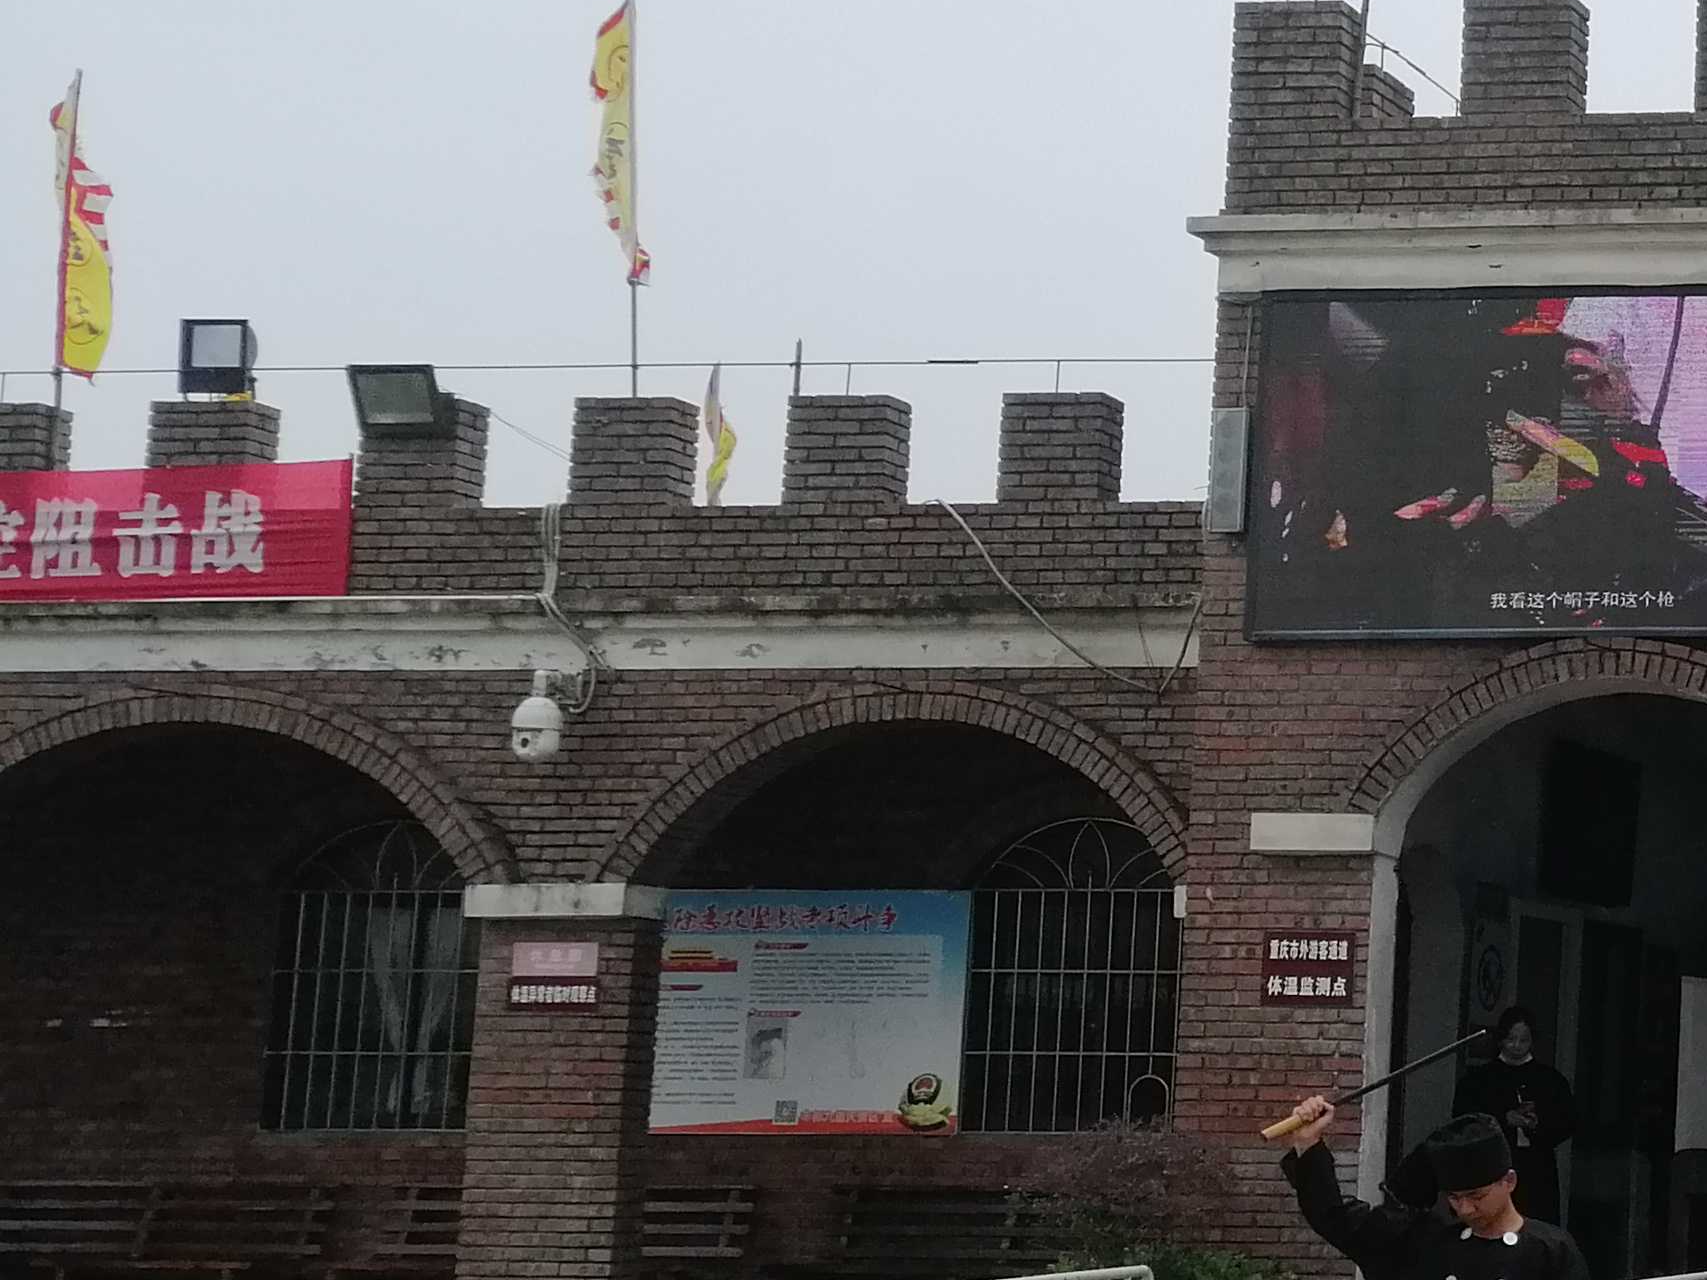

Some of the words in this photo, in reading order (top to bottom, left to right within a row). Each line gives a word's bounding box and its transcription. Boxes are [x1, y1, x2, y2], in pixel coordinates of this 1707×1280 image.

[1489, 590, 1675, 609] 我看这个帽子和这个枪
[666, 903, 898, 932] 除恶攻坚战专项斗争
[1269, 938, 1349, 960] 重庆市外游客通道
[1267, 975, 1348, 997] 体温监测点
